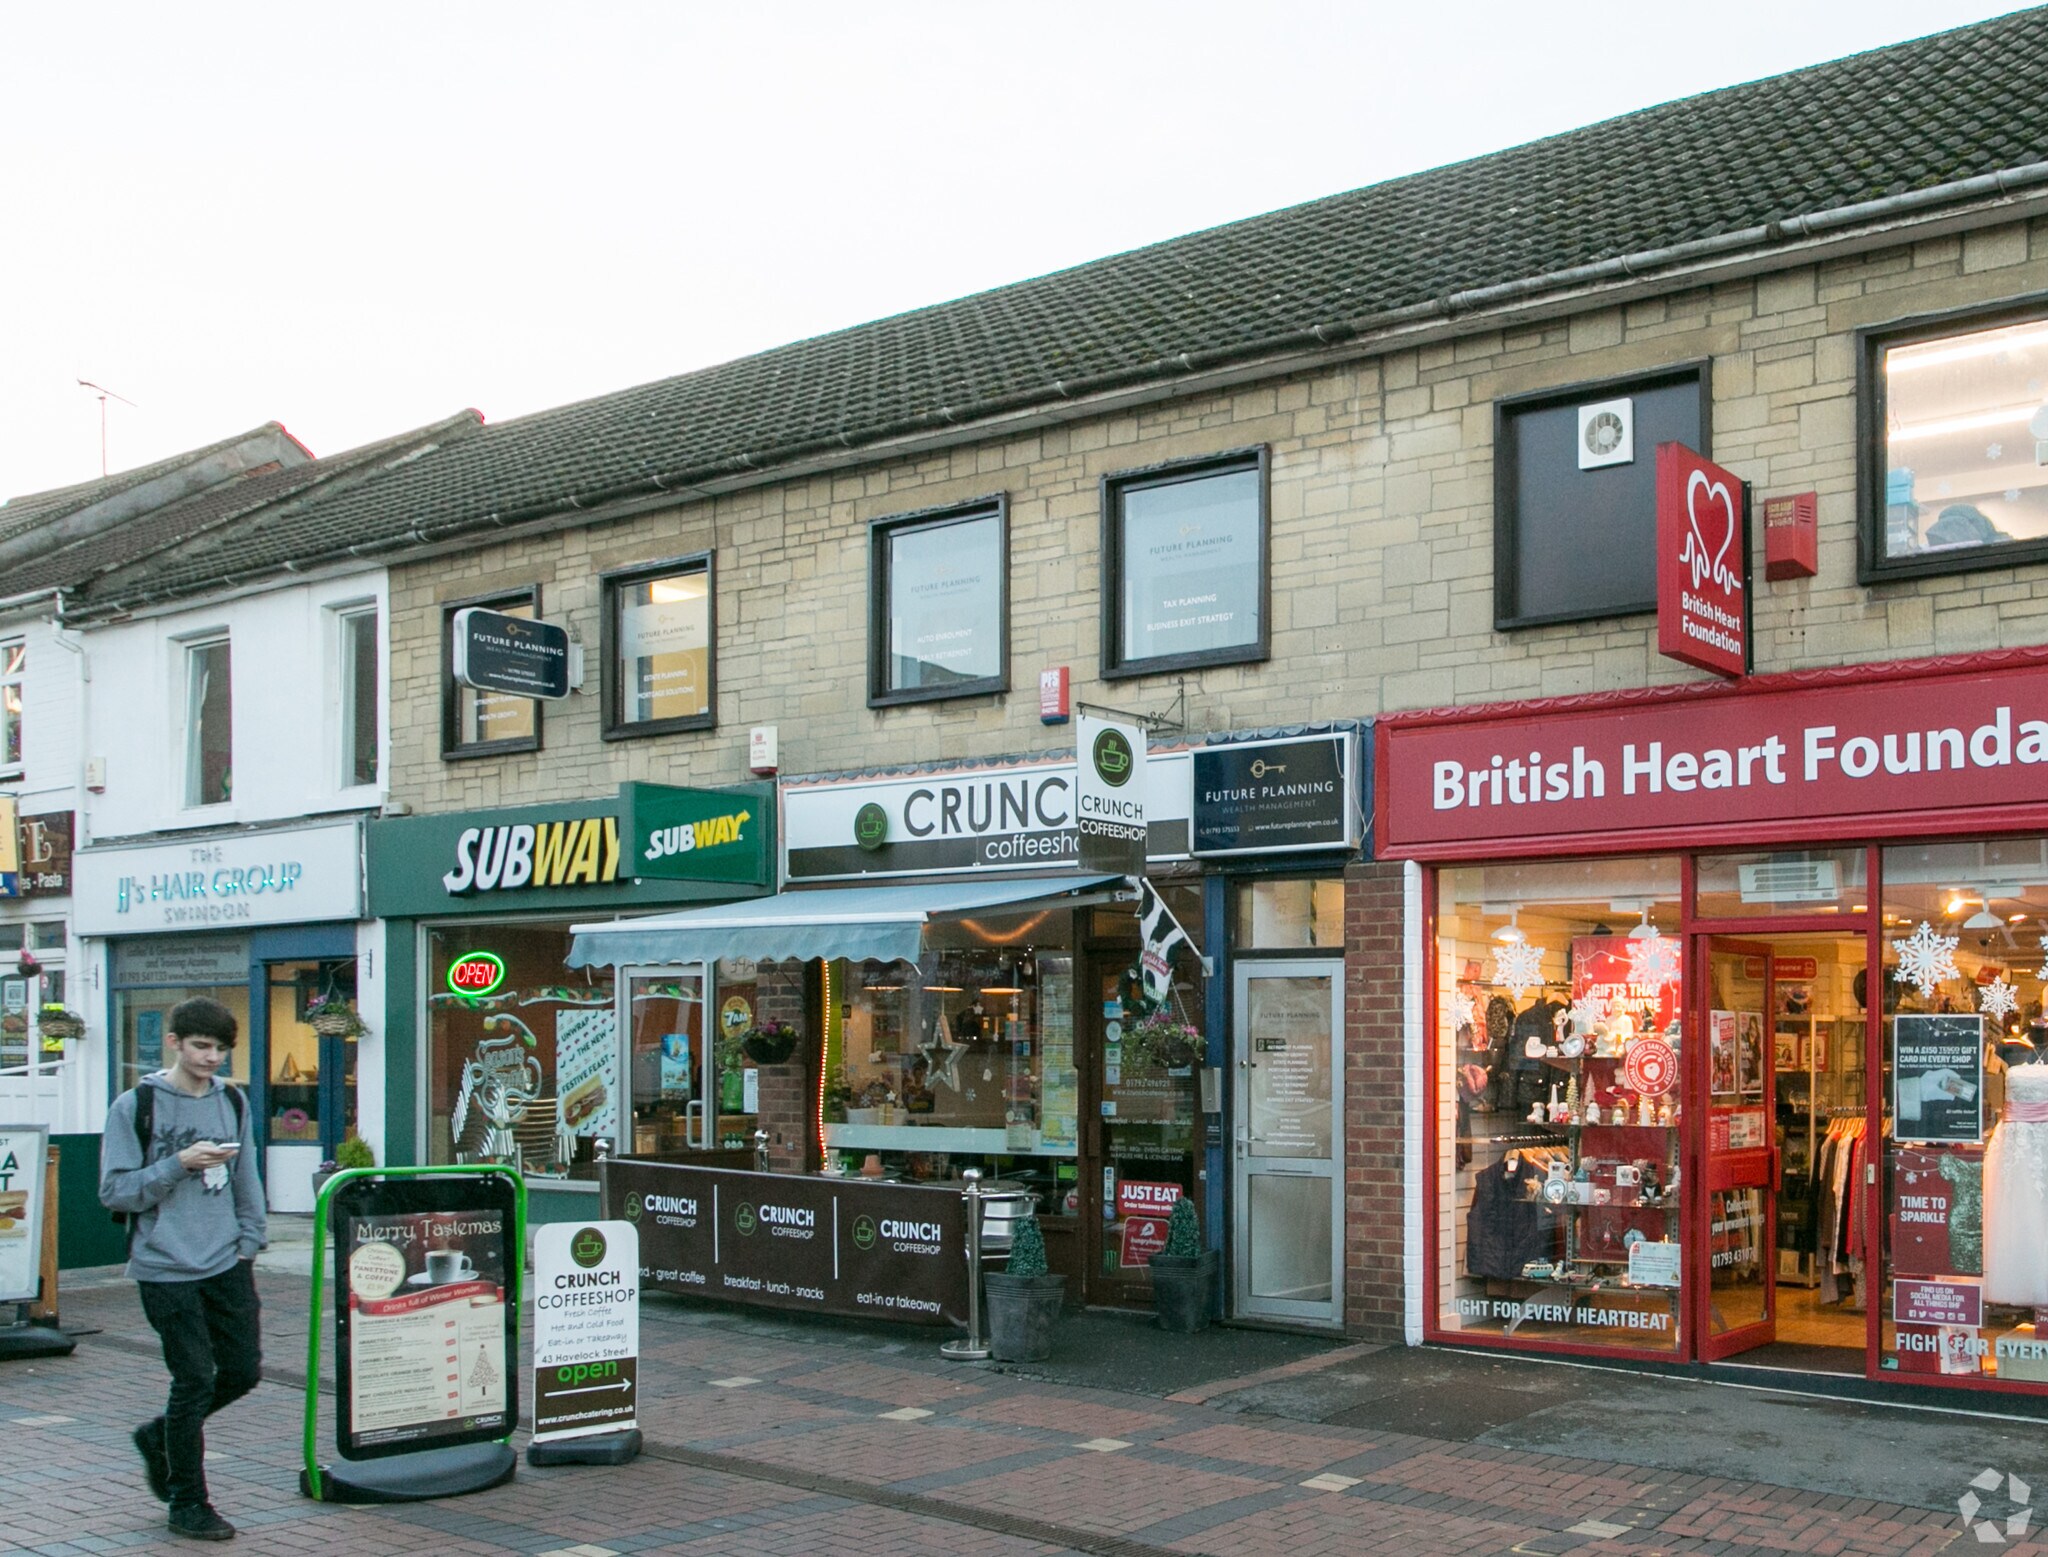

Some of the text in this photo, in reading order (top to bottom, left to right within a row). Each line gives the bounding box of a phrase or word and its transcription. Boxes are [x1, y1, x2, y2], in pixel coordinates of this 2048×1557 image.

[1150, 535, 1233, 554] FUTURE PLANNING
[1163, 593, 1217, 608] TAX PLANNING
[1682, 591, 1741, 632] British Heart
[1147, 612, 1234, 631] BUSINESS EXIT STRATEGY
[1682, 615, 1741, 655] Foundation
[473, 633, 564, 657] FUTURE PLANNING
[1433, 746, 1605, 811] British
[1622, 735, 1787, 796] Heart
[1205, 780, 1334, 803] FUTURE PLANNING
[904, 777, 1078, 837] CRUNC
[1081, 794, 1143, 820] CRUNCH
[1222, 799, 1317, 814] WEALTH MANAGEMENT
[644, 810, 750, 861] SUBWAY
[1080, 819, 1146, 841] COFFEESHOP
[190, 846, 223, 863] THE
[443, 816, 620, 893] SUBWAY
[38, 872, 63, 888] Pasta
[152, 871, 206, 901] HAIR
[213, 861, 302, 898] GROUP
[164, 902, 250, 923] SWINDON
[455, 963, 497, 988] OPEN
[1591, 983, 1661, 997] GIFTS THAT
[1628, 998, 1662, 1012] MORE
[561, 1016, 589, 1042] UNWRAP
[724, 1011, 748, 1028] 7AM
[577, 1029, 607, 1056] THE NEW
[1647, 1042, 1666, 1053] SANTA
[1899, 1046, 1978, 1055] WIN A £150 TESCO GIFT
[1899, 1055, 1972, 1063] CARD IN EVERY SHOP
[561, 1054, 609, 1094] FESTIVE FEAST
[1121, 1185, 1179, 1202] JUST EAT
[1900, 1195, 1947, 1210] TIME TO
[645, 1195, 697, 1216] CRUNCH
[1138, 1202, 1160, 1211] takeaway
[656, 1214, 697, 1228] COFFEESHOP
[759, 1204, 815, 1227] CRUNCH
[1900, 1210, 1946, 1223] SPARKLE
[356, 1222, 415, 1241] Merry
[771, 1226, 815, 1240] COFFEESHOP
[880, 1219, 942, 1241] CRUNCH
[893, 1241, 942, 1255] COFFEESHOP
[1712, 1250, 1733, 1268] 01793
[365, 1274, 394, 1283] COFFEE
[555, 1270, 620, 1289] CRUNCH
[656, 1269, 706, 1285] great coffee
[724, 1274, 824, 1300] breakfast lunch snacks
[383, 1302, 407, 1313] Drinks
[408, 1299, 419, 1309] full
[454, 1284, 481, 1297] Wonder
[538, 1288, 636, 1310] COFFEESHOP
[856, 1292, 942, 1315] eat-in or takeaway
[1926, 1300, 1947, 1308] THINGS
[564, 1306, 612, 1318] Fresh Coffee
[1493, 1301, 1521, 1318] FOR
[1525, 1302, 1573, 1322] EVERY
[1576, 1306, 1670, 1330] HEARTBEAT
[551, 1318, 624, 1332] Hot and Cold Food
[548, 1337, 575, 1347] Eat-in
[586, 1332, 628, 1344] Takeaway
[1954, 1336, 1989, 1356] FOR
[542, 1347, 629, 1363] 43 Havelock Street
[557, 1361, 618, 1386] open
[475, 1415, 502, 1425] CRUNCH
[538, 1404, 634, 1425] www.crunchcatering.co.uk
